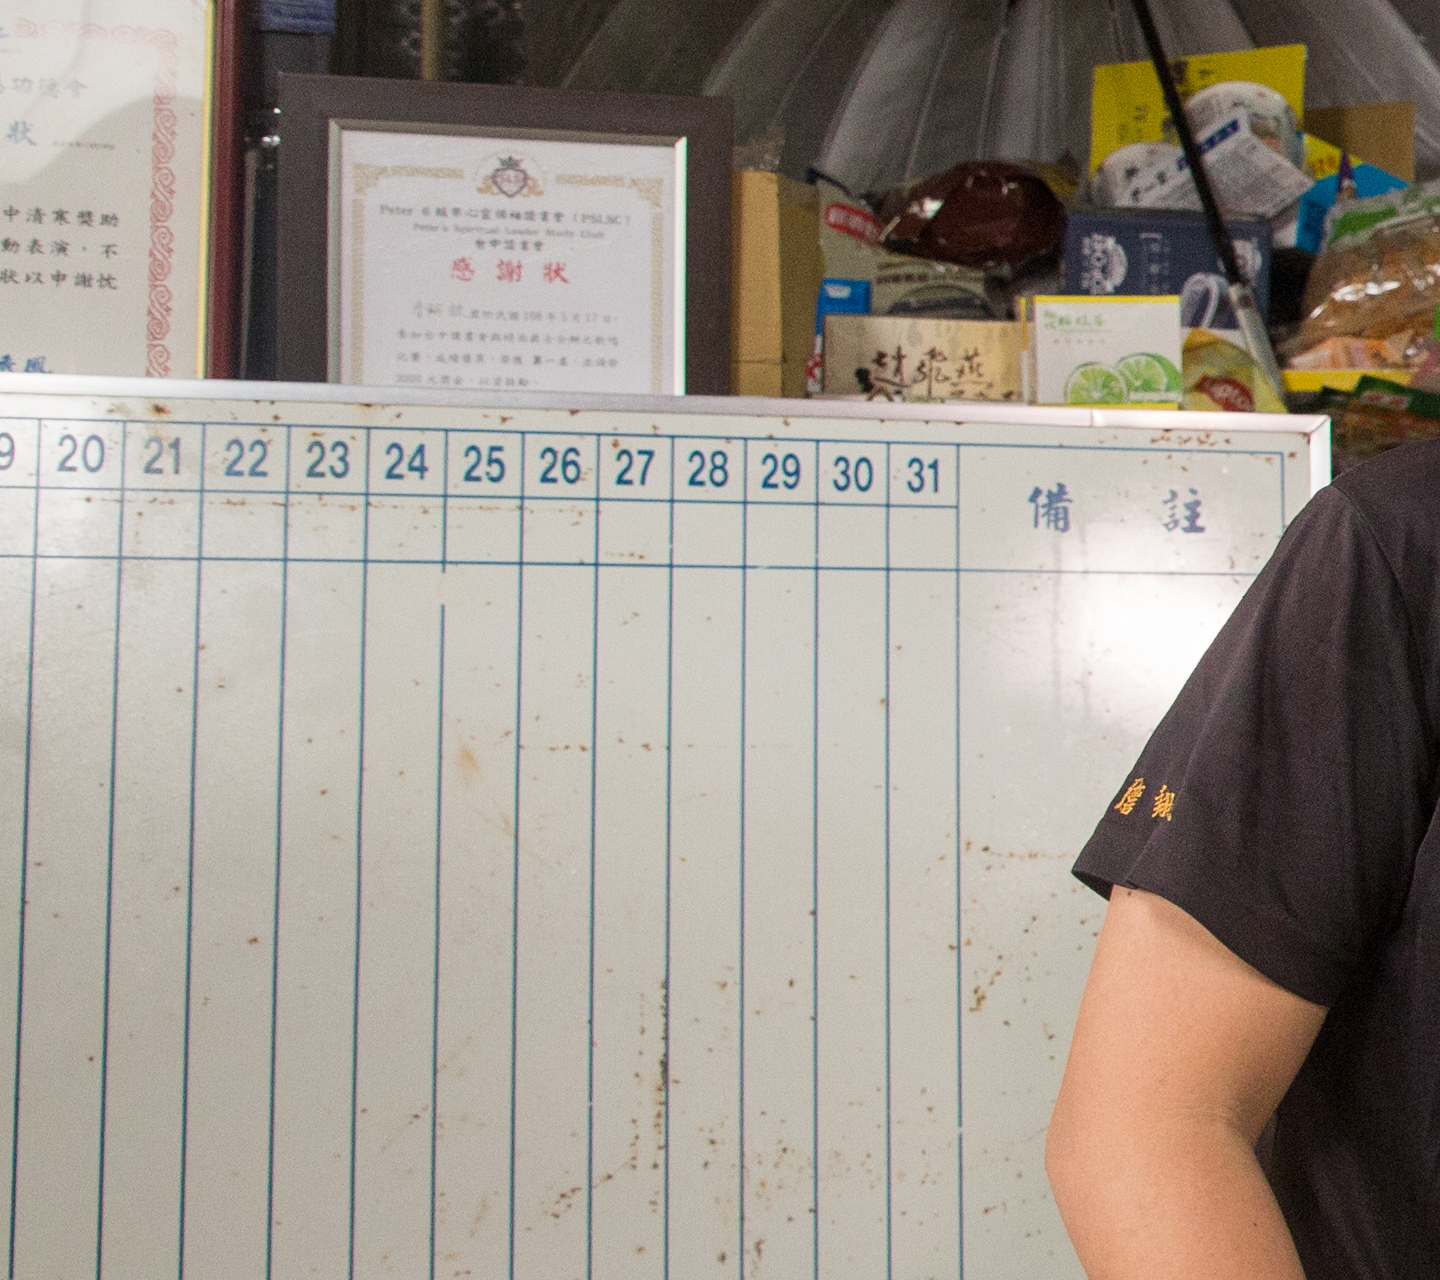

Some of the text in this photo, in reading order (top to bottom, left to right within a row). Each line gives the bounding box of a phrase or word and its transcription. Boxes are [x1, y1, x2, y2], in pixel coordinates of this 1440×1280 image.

[452, 256, 570, 285] 感謝狀
[57, 433, 1208, 536] 20 21 22 23 24 25 26 27 28 29 30 31 備註
